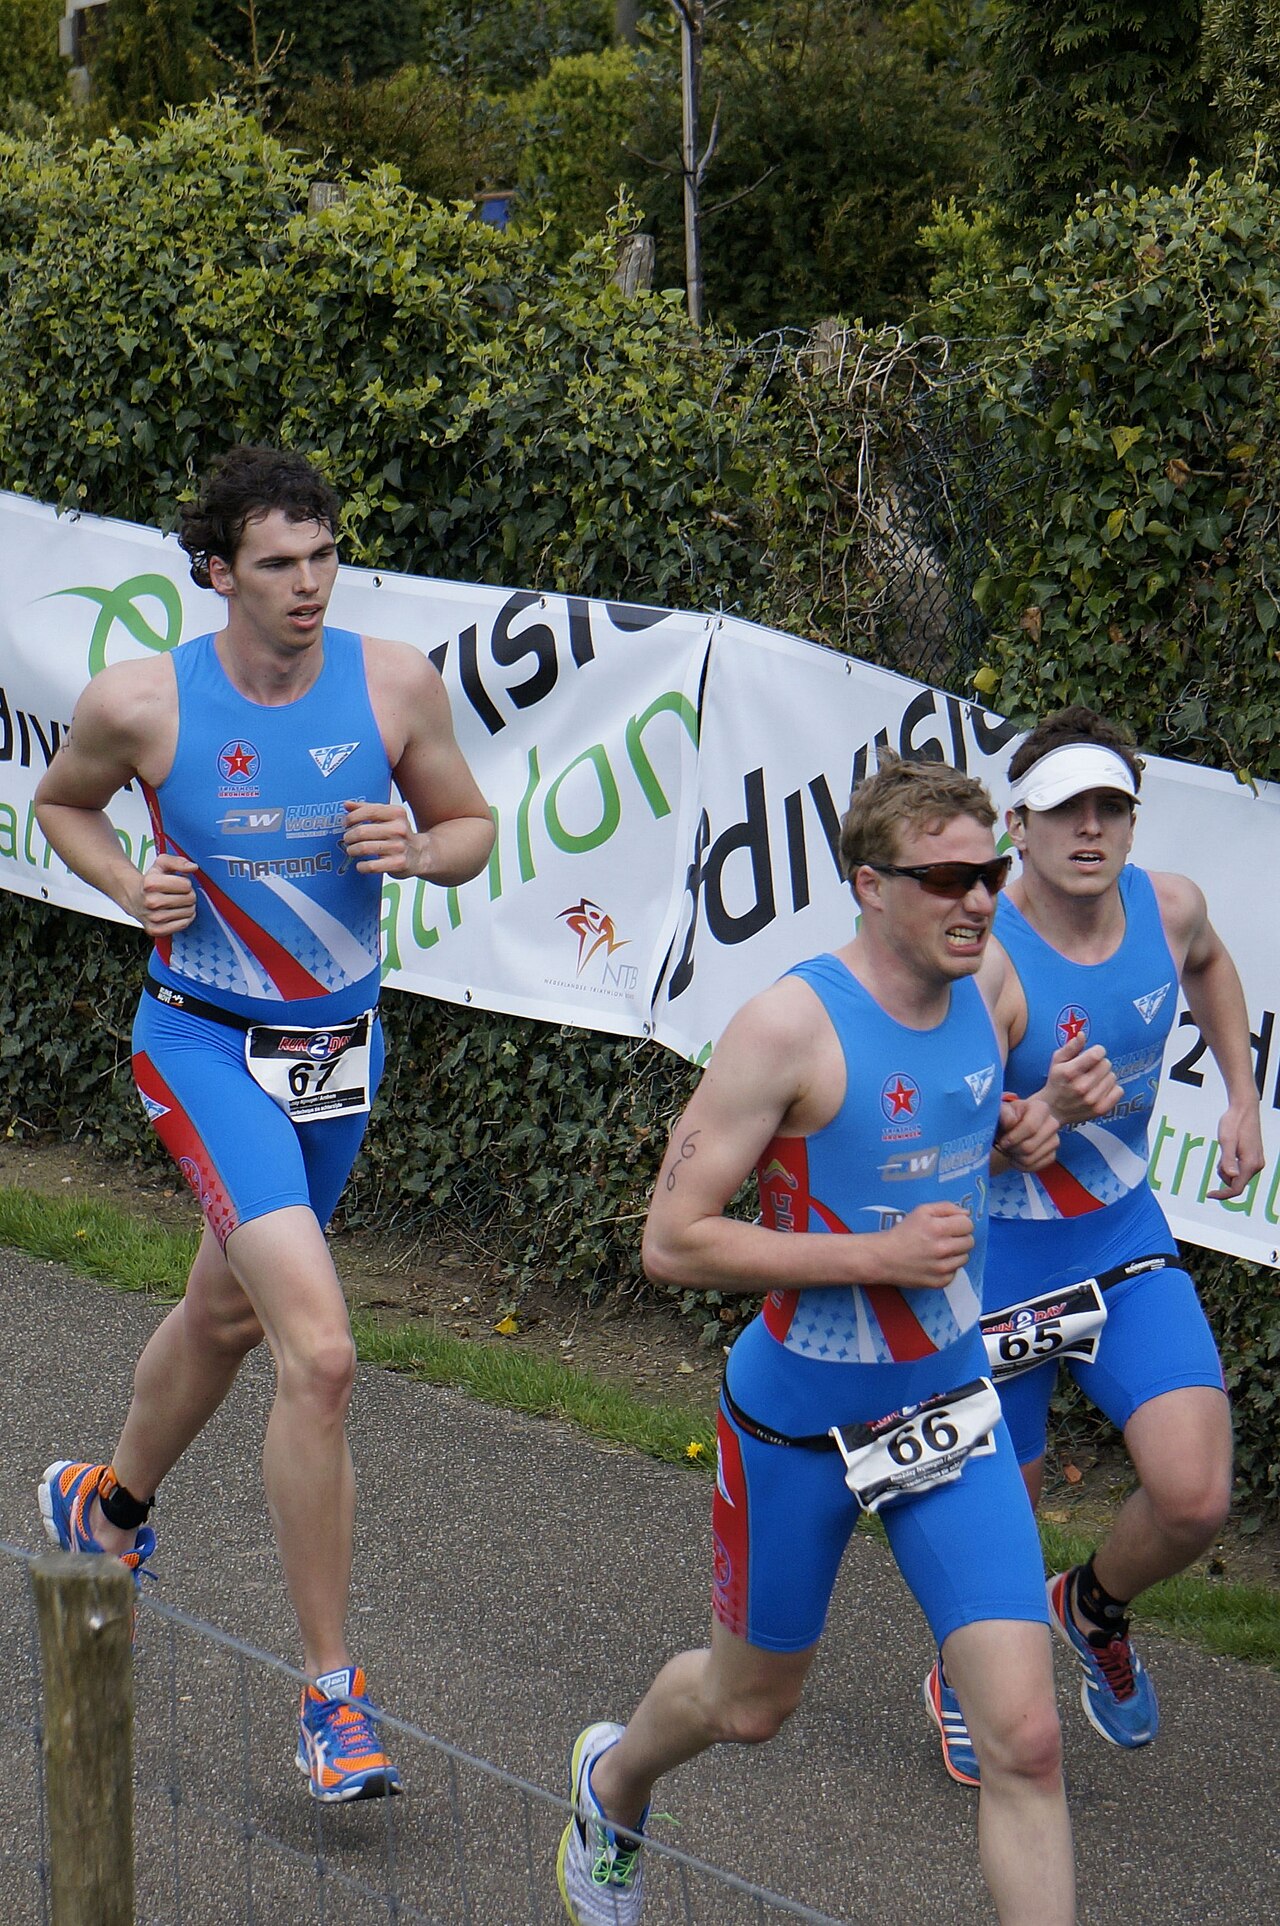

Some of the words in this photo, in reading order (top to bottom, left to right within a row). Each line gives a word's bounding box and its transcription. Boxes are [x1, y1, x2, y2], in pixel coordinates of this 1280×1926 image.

[589, 985, 624, 997] TRIATHLON
[602, 962, 639, 990] NTB
[289, 1058, 341, 1097] 67
[999, 1319, 1064, 1361] 65
[887, 1410, 959, 1466] 66
